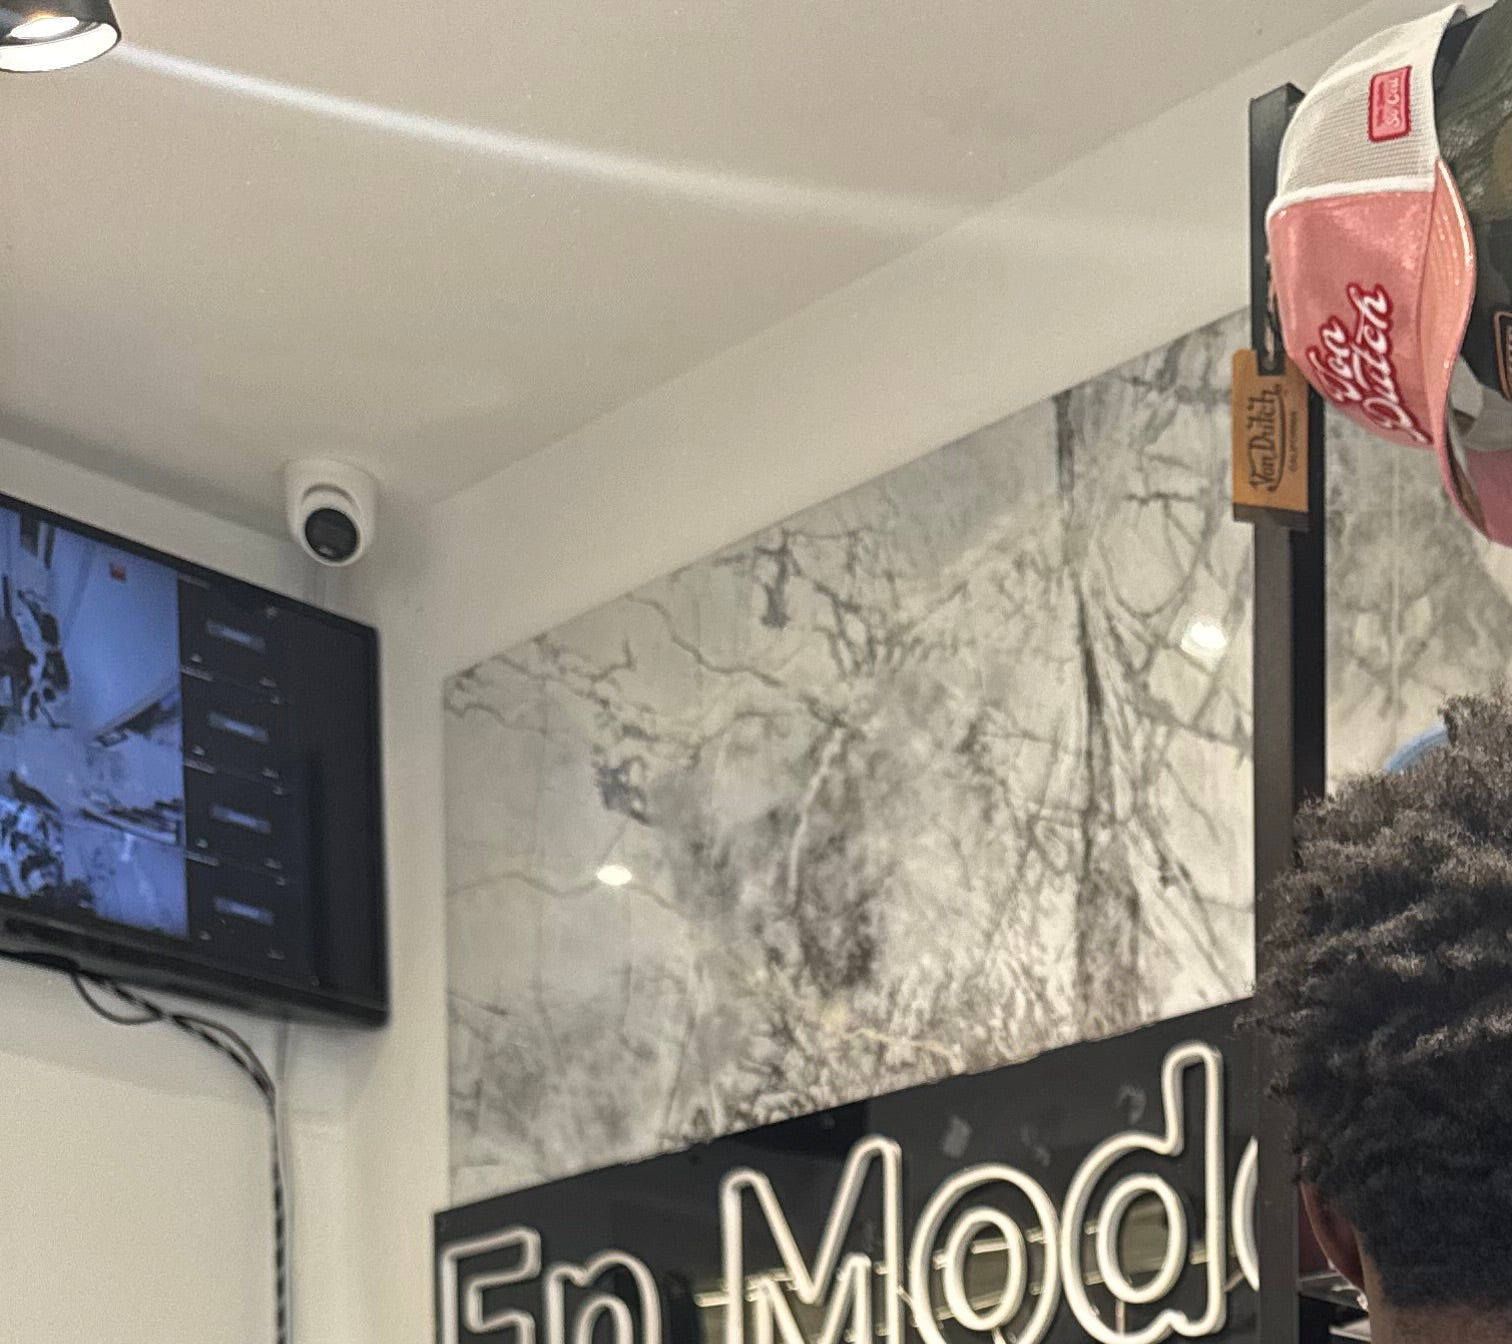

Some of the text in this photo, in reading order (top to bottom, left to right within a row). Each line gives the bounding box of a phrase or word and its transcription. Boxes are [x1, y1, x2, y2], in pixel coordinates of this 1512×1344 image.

[1306, 318, 1364, 404] Von
[1348, 283, 1434, 444] Dutch
[1246, 384, 1282, 452] Dutch
